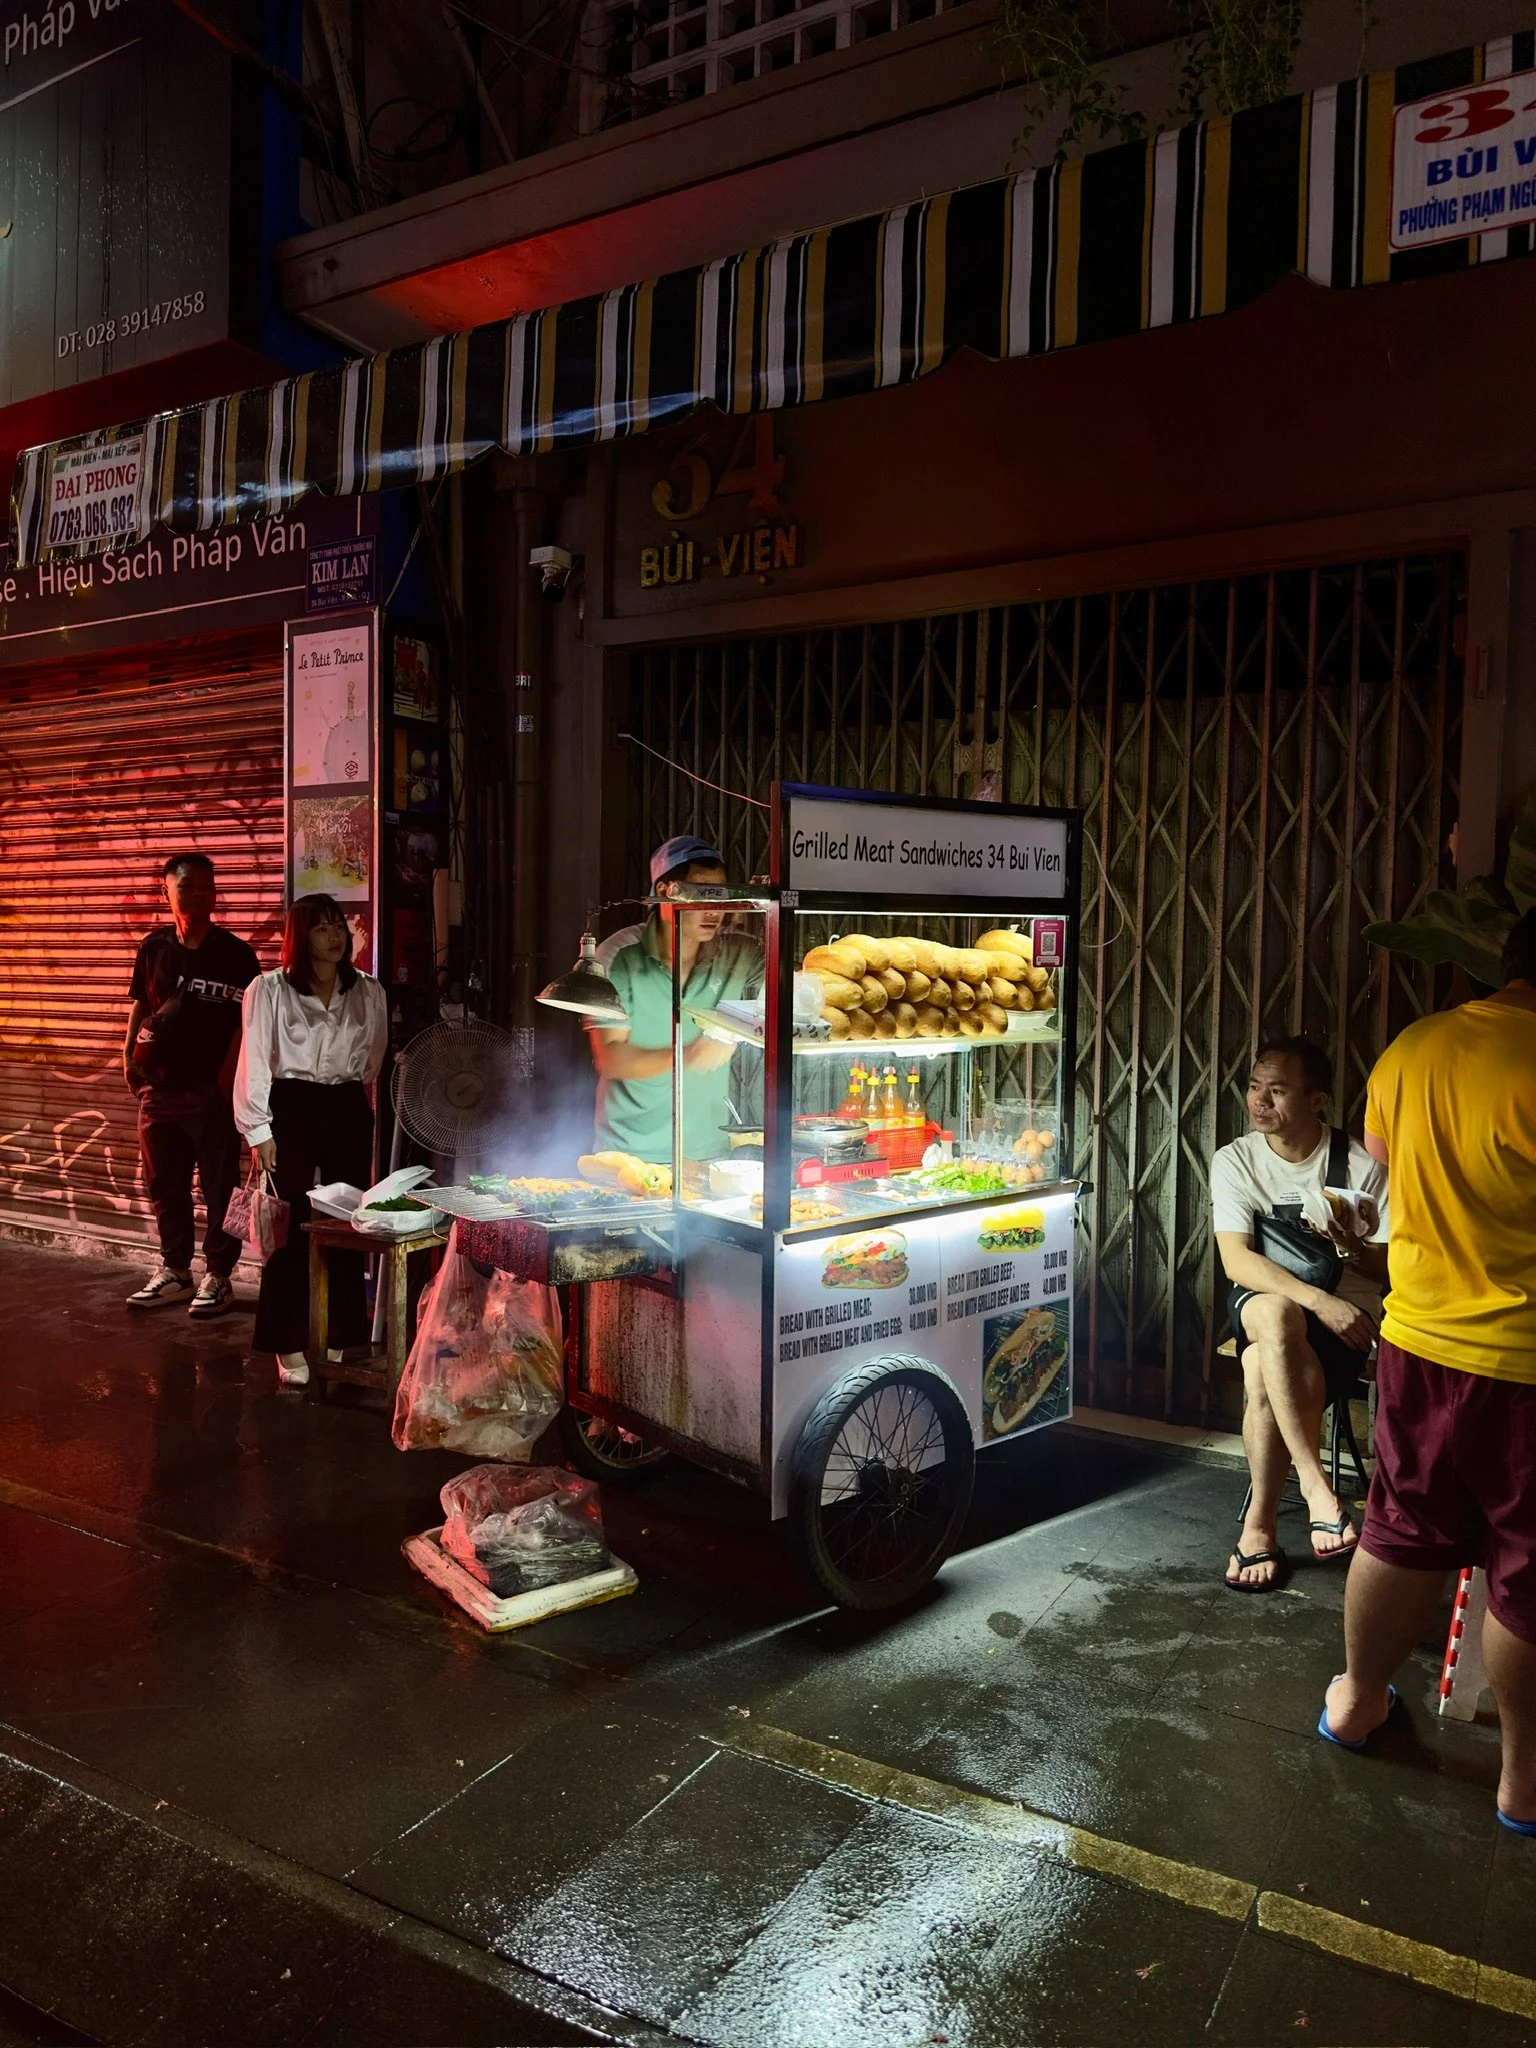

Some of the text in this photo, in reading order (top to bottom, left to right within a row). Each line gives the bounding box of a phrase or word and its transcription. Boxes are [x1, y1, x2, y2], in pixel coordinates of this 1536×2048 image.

[5, 0, 76, 66] Pháp
[1415, 90, 1536, 143] 3
[1427, 146, 1498, 187] BÙI
[1399, 196, 1458, 236] PHƯỜNG
[1462, 187, 1506, 223] PHẠM
[86, 320, 116, 348] 028
[120, 290, 206, 337] 39147858
[55, 463, 138, 504] ĐẠI PHONG
[650, 411, 787, 522] 34
[38, 558, 95, 598] Hiệu
[101, 540, 163, 585] Sách
[173, 529, 243, 573] Pháp
[251, 514, 307, 558] Văn
[311, 553, 370, 585] KIM LAN
[640, 517, 799, 588] BÙI VIỆN
[298, 648, 364, 670] Le Petit Prince
[792, 830, 1061, 872] Grilled Meat Sandwiches 34 Bui Vien
[947, 1273, 965, 1296] BREAD
[966, 1269, 980, 1291] WITH
[980, 1264, 1000, 1287] GRILLED
[779, 1313, 804, 1336] BREAD
[805, 1307, 824, 1329] WITH
[825, 1302, 852, 1326] GRILLED
[853, 1297, 872, 1319] MEAT:
[947, 1300, 964, 1322] BREAD
[978, 1291, 997, 1313] GRILLED
[997, 1287, 1009, 1308] BEEF
[1009, 1285, 1020, 1305] AND
[1020, 1282, 1030, 1301] EGG
[779, 1340, 801, 1363] BREAD
[802, 1335, 818, 1357] WITH
[819, 1330, 843, 1354] GRILLED
[844, 1326, 860, 1348] MEAT
[860, 1323, 873, 1344] AND
[873, 1319, 889, 1340] FRIED
